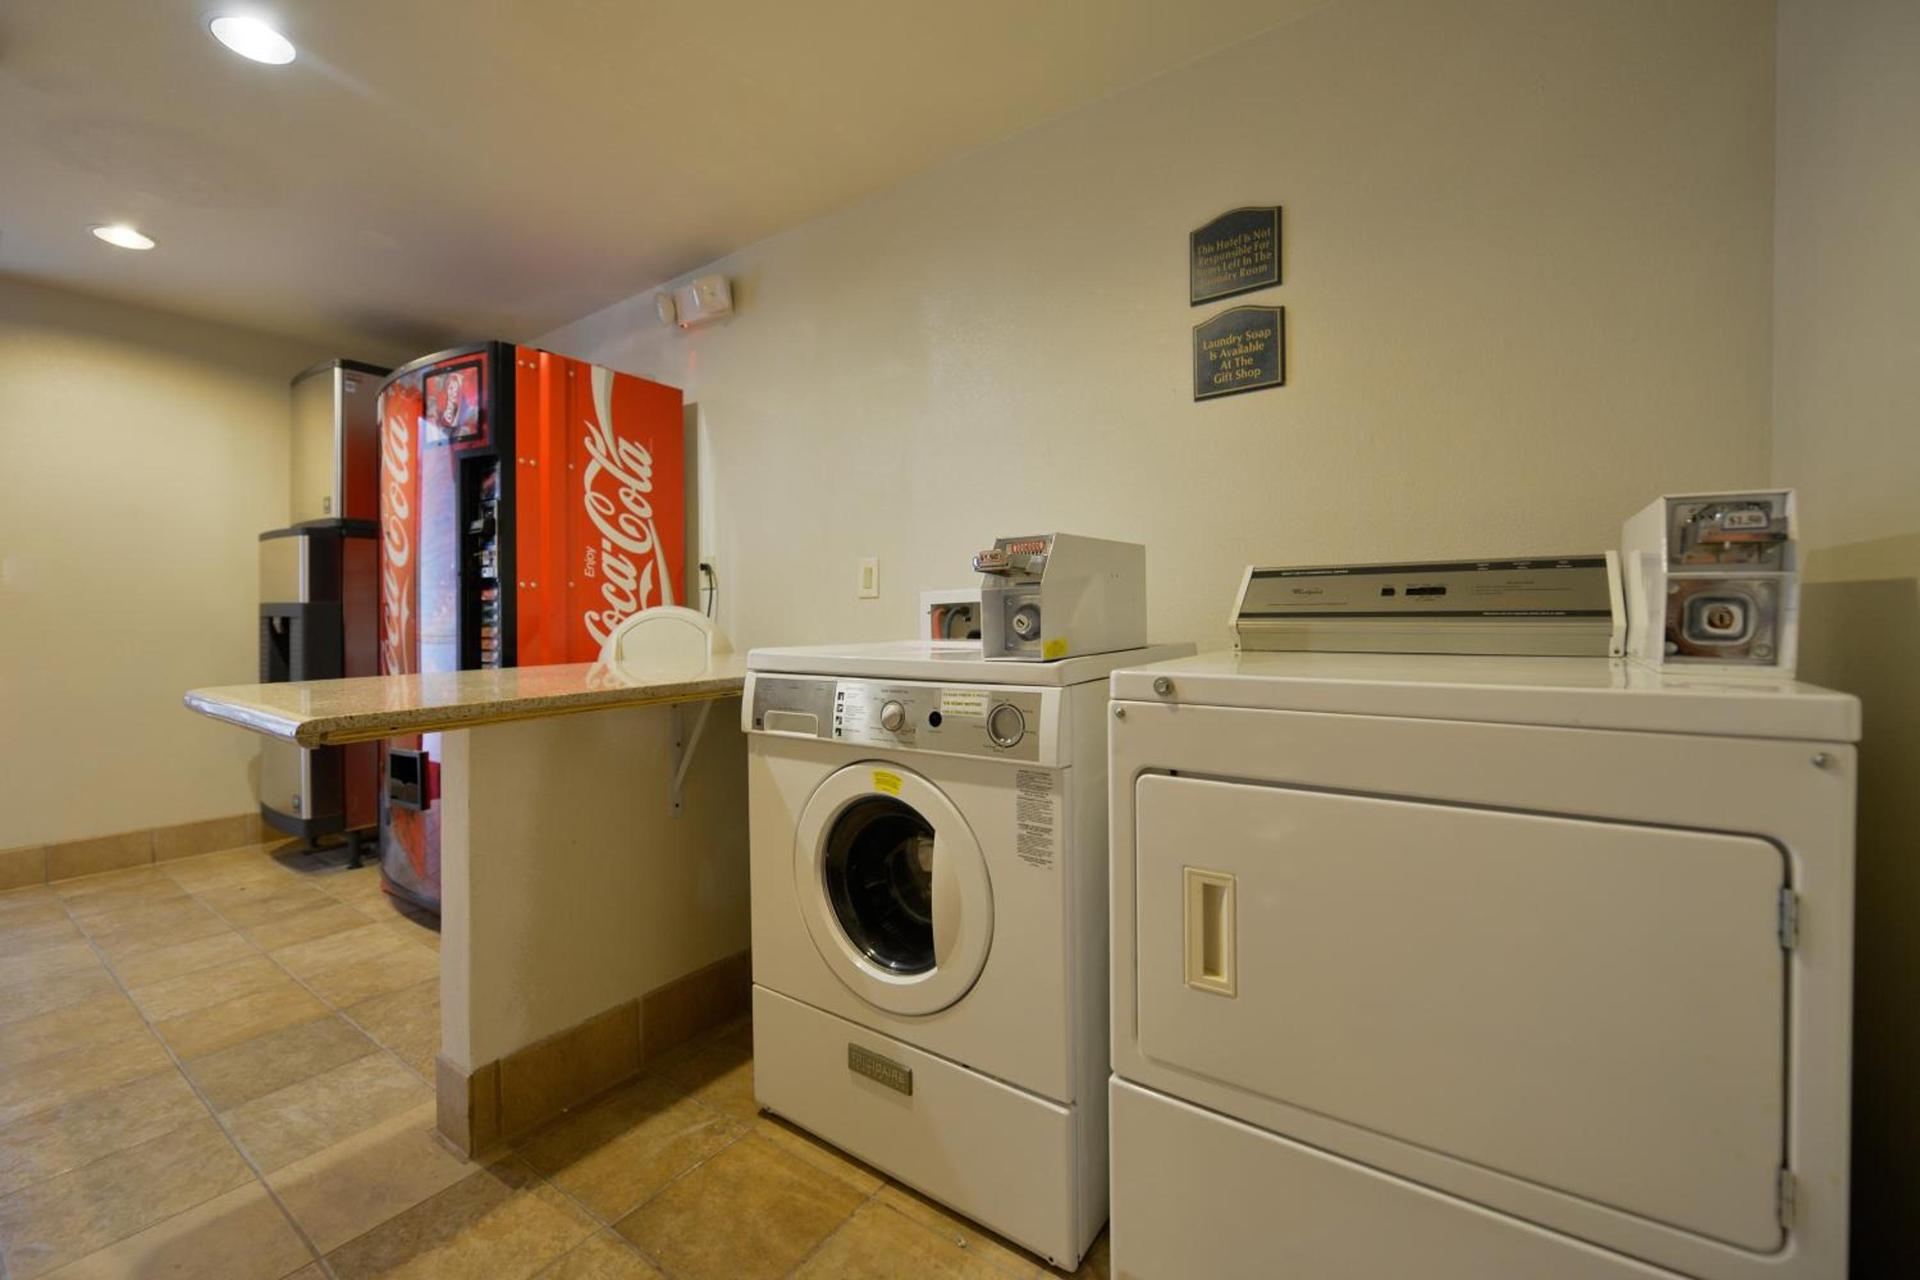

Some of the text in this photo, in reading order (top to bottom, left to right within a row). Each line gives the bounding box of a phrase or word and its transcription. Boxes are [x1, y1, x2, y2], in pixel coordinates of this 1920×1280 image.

[1216, 234, 1243, 251] Hotel
[1253, 227, 1270, 241] Not
[1198, 240, 1270, 267] Responsible For
[1222, 256, 1241, 271] Left
[1243, 256, 1252, 266] In
[1254, 250, 1272, 263] The
[1239, 264, 1268, 278] Room
[1202, 328, 1272, 351] Laundry Soap
[1209, 341, 1265, 361] Is Available
[1221, 356, 1254, 370] At The
[1213, 367, 1262, 385] Gift Shop
[583, 545, 597, 578] Enjoy
